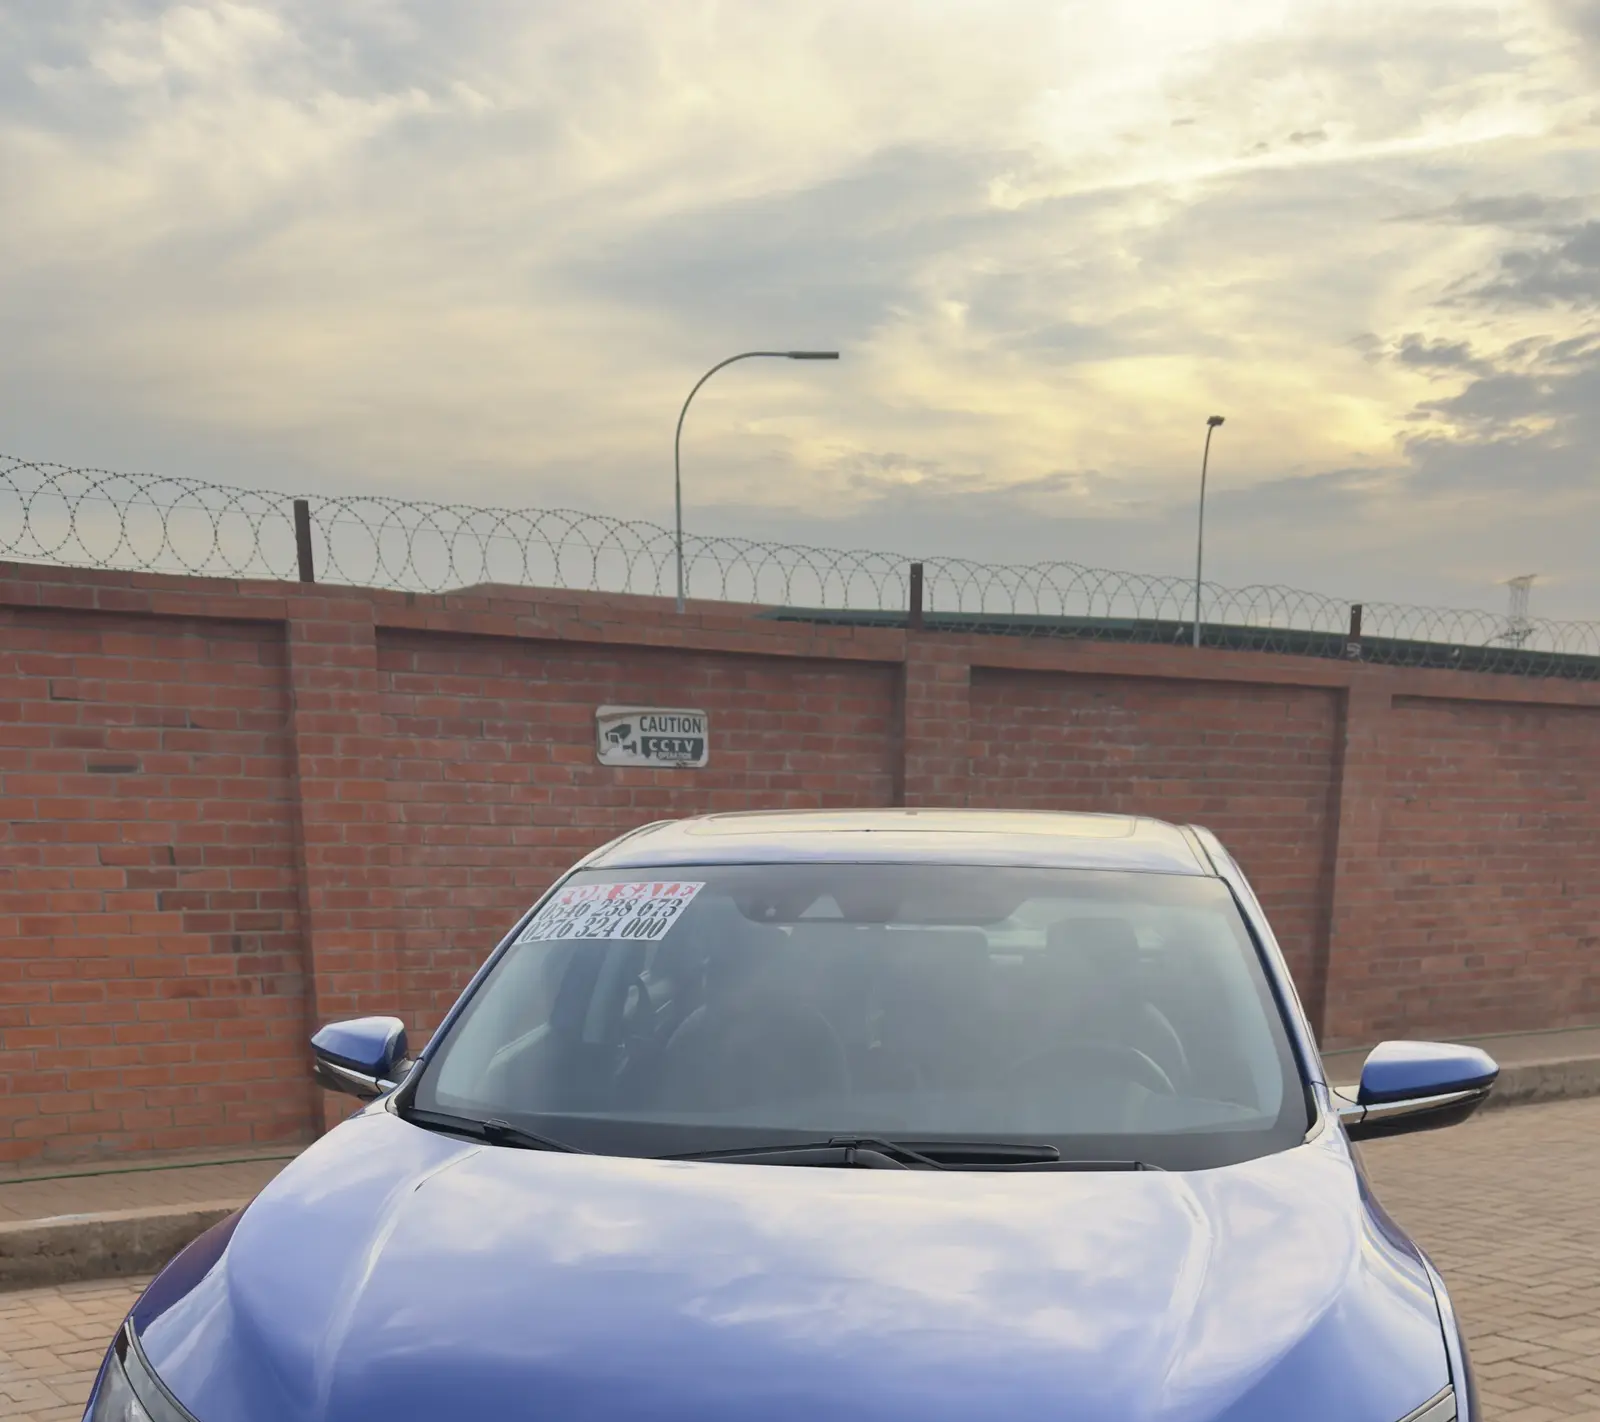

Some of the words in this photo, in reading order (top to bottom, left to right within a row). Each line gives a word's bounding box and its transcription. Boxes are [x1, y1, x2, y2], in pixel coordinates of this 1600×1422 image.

[640, 716, 702, 733] CAUTION
[648, 739, 694, 752] CCTV
[538, 901, 592, 921] 0546
[591, 899, 638, 918] 238
[637, 898, 684, 918] 673
[521, 918, 574, 942] 0276
[574, 917, 623, 939] 324
[620, 918, 668, 939] 000
